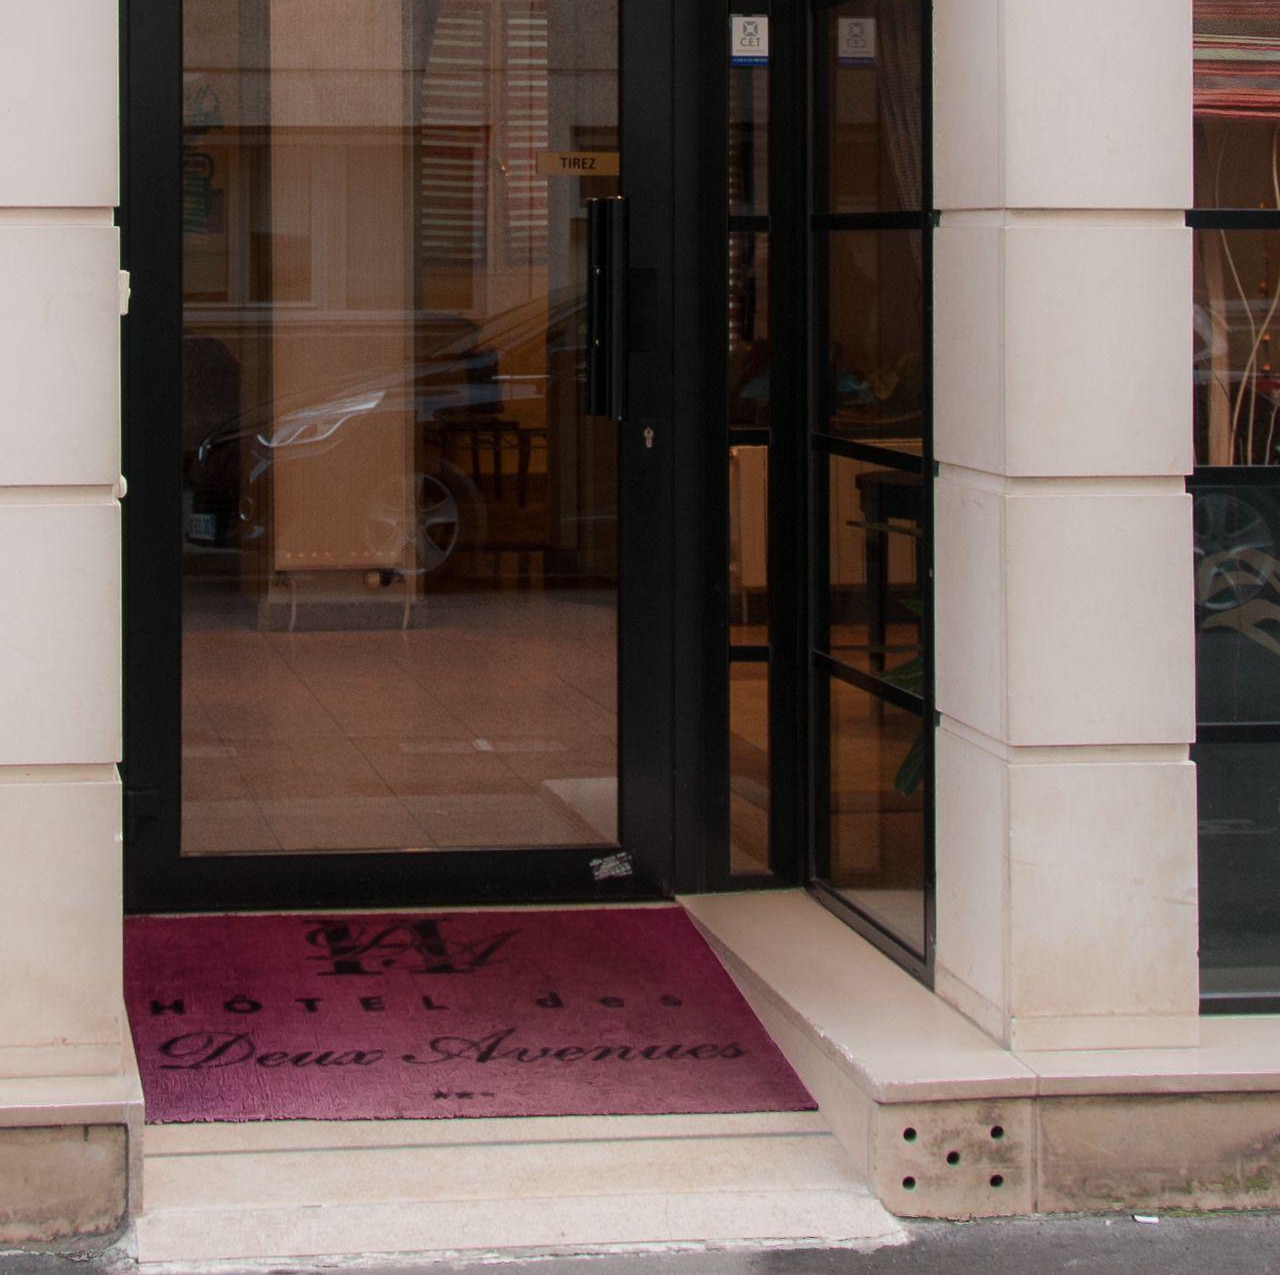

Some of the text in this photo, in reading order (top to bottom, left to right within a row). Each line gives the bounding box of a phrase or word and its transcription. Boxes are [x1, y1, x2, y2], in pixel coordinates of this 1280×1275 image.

[560, 156, 596, 170] TIREZ
[150, 994, 450, 1015] HÔTEL
[158, 1028, 747, 1070] Deux Avenues
